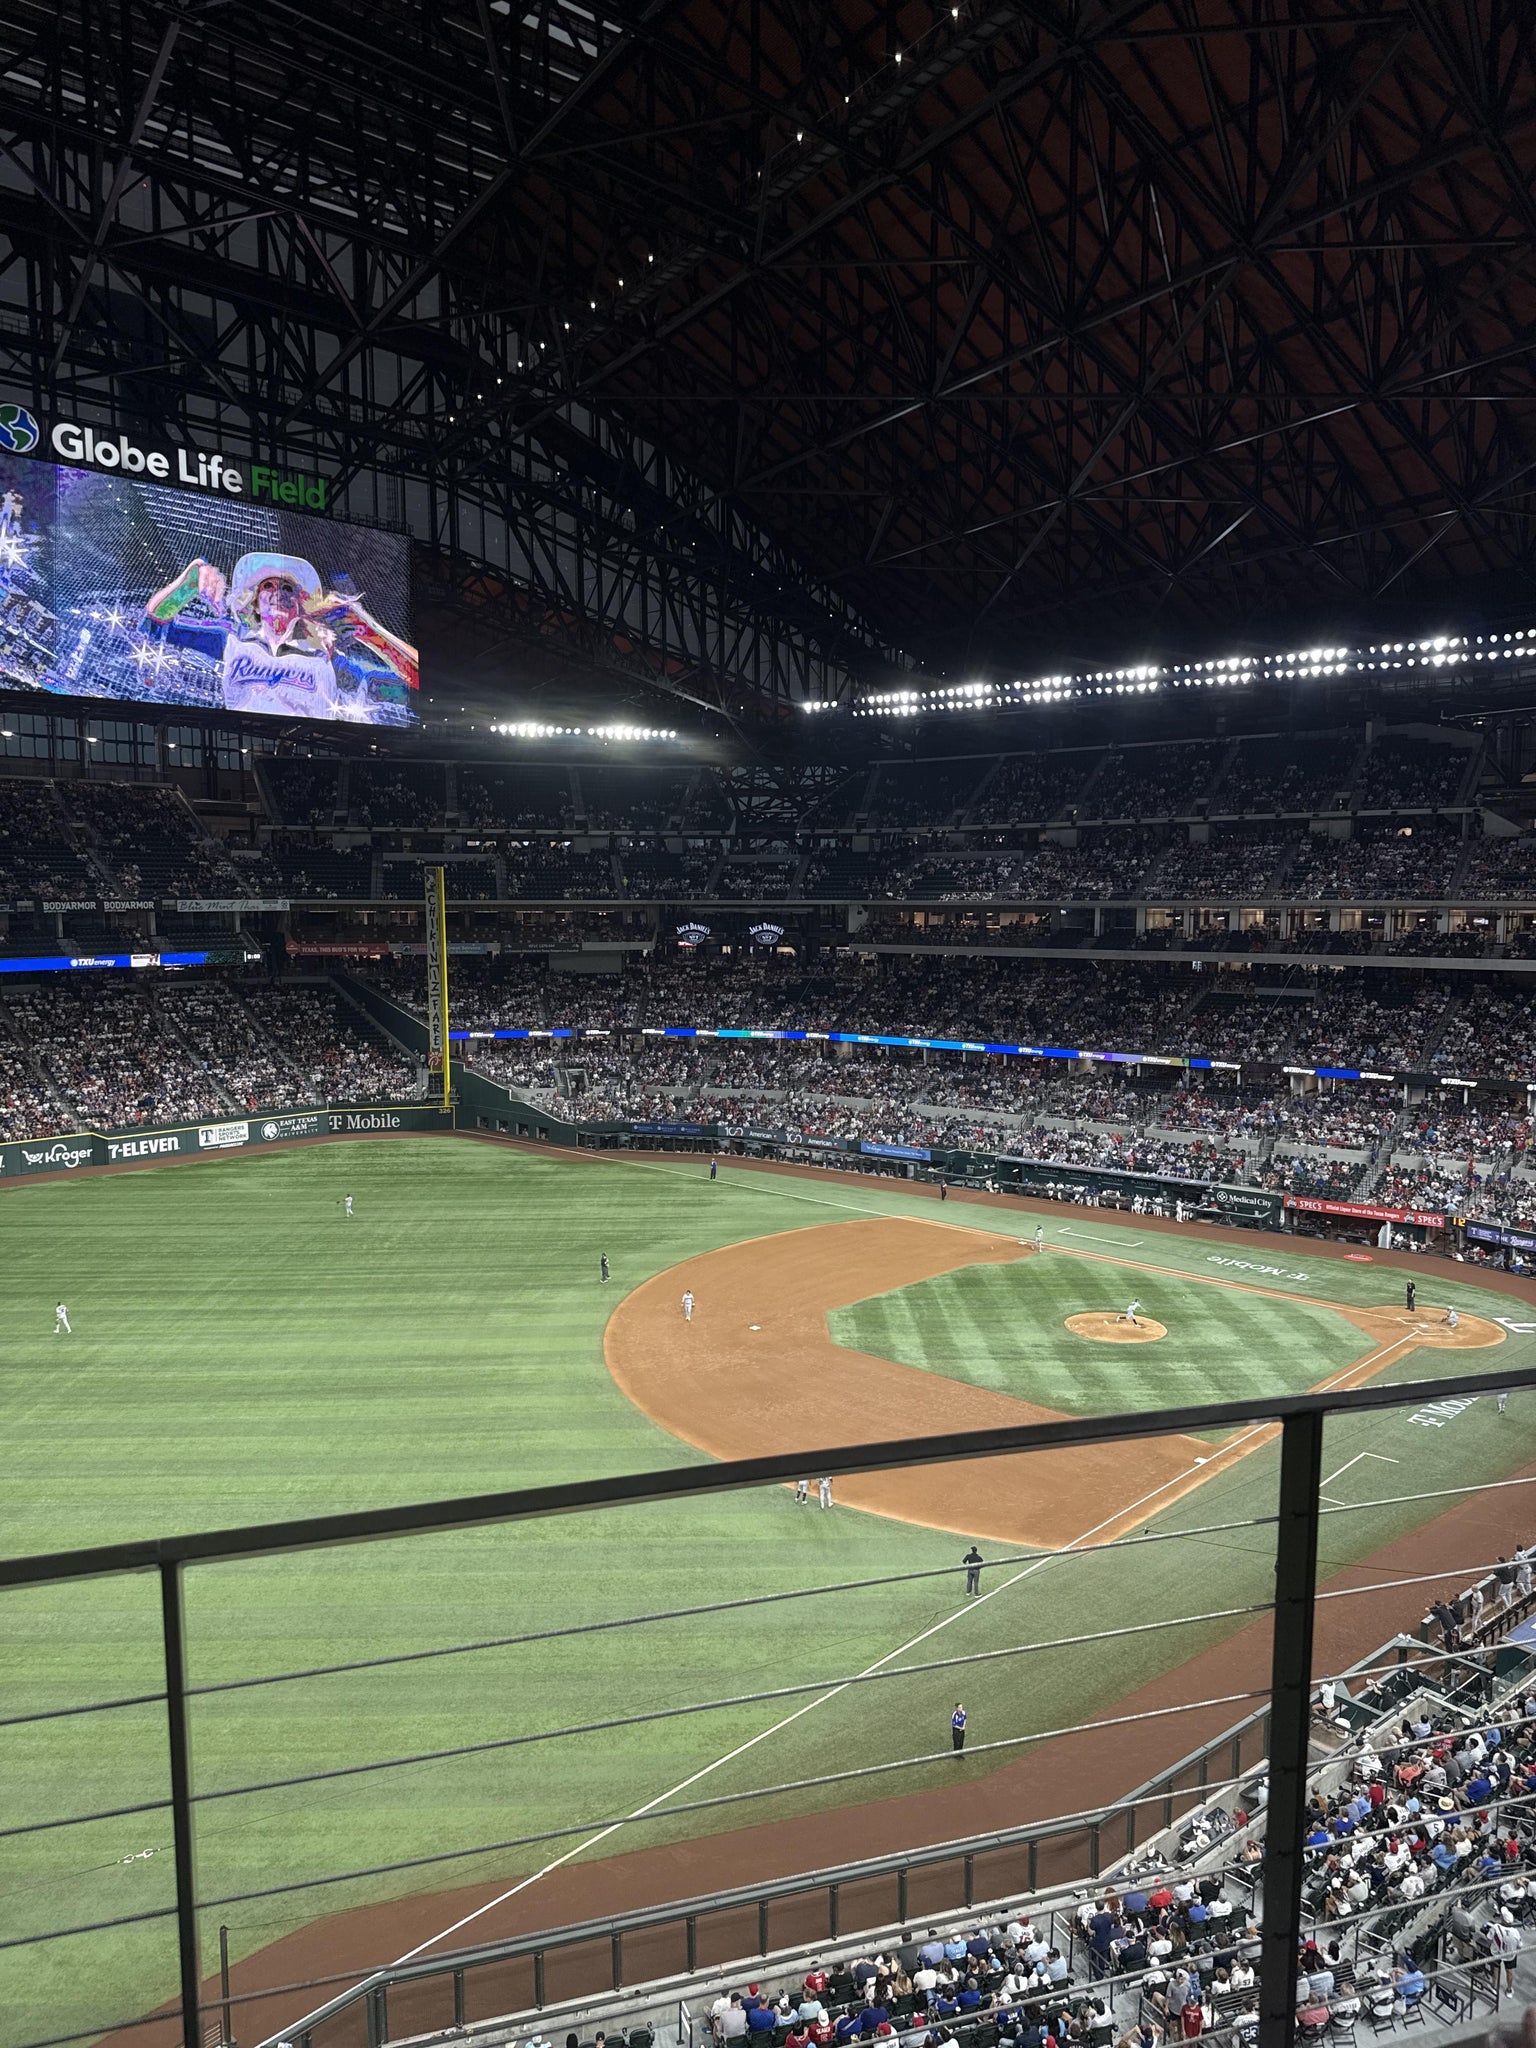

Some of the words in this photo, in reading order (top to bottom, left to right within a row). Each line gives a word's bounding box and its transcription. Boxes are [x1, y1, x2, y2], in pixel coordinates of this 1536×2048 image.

[51, 422, 169, 478] Globe
[178, 449, 243, 493] Life
[251, 465, 326, 510] Field
[43, 901, 97, 911] BODYARMOR
[104, 901, 155, 910] BODYARMOR
[290, 1123, 308, 1131] A&M
[346, 1113, 401, 1131] Mobile
[749, 1131, 772, 1139] American
[808, 1138, 833, 1147] American
[45, 1143, 93, 1168] Kroger
[1229, 1194, 1257, 1205] Medical
[1257, 1198, 1272, 1208] City
[1299, 1200, 1322, 1211] SPEC'S
[1417, 1214, 1443, 1226] SPEC'S
[1206, 1255, 1287, 1276] Mobile
[1433, 1824, 1439, 1833] 5
